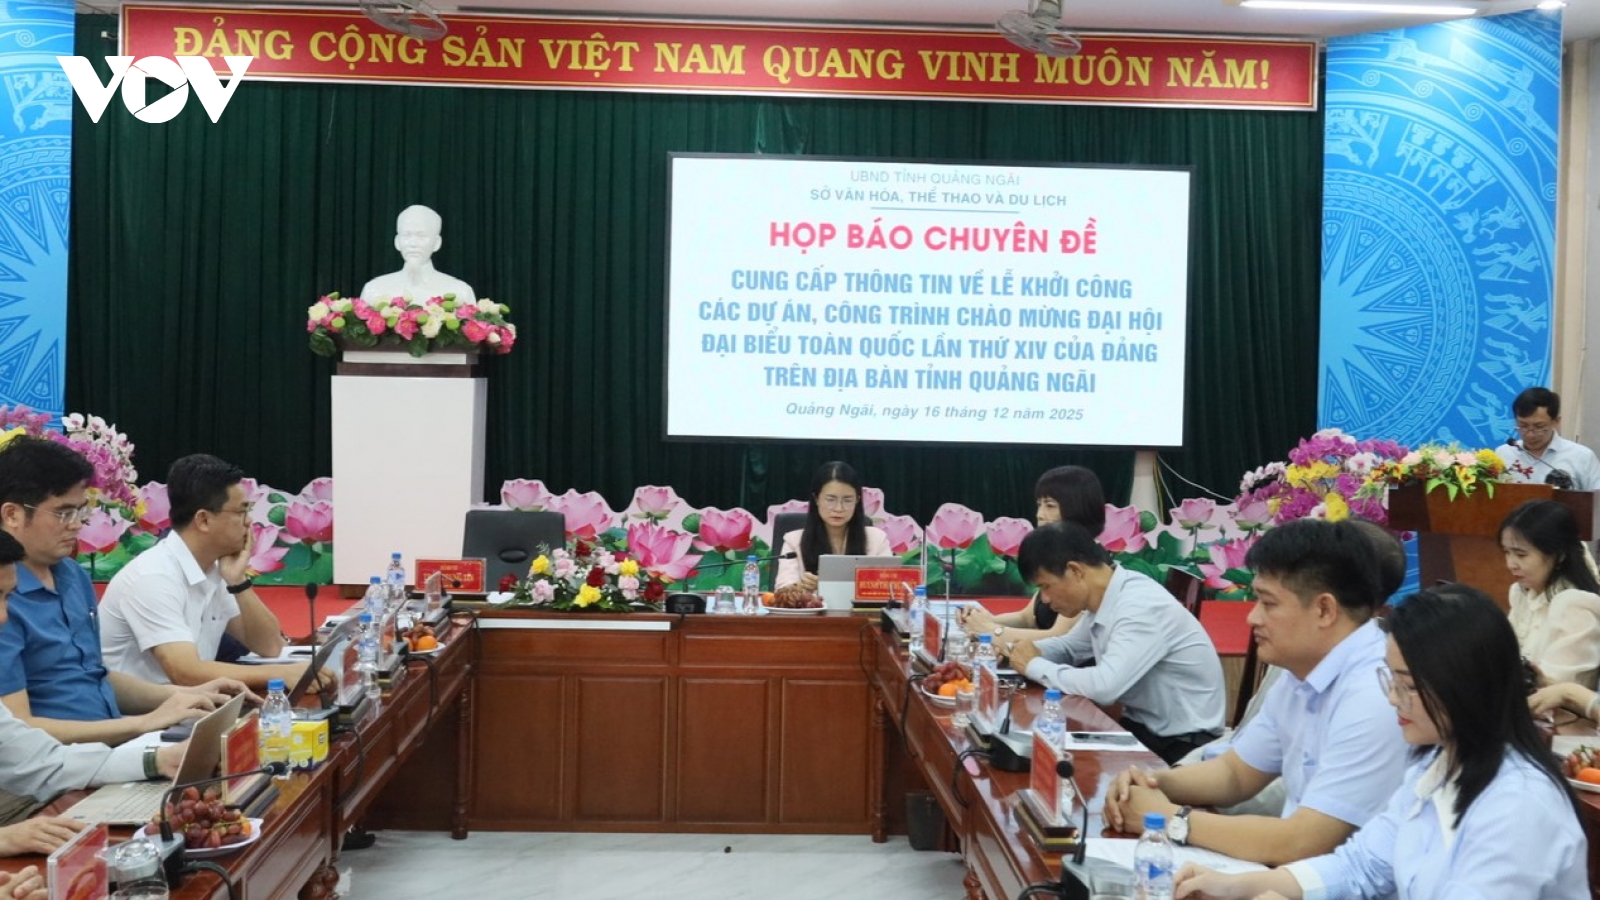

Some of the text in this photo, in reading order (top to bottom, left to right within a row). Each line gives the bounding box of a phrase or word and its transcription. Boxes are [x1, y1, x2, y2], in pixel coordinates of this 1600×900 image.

[174, 17, 1270, 90] ĐẢNG CỘNG SẢN VIỆT NAM QUANG VINH MUÔN NĂM!
[850, 170, 889, 183] UBND
[931, 169, 983, 186] QUẢNG
[810, 185, 1067, 208] SỞ VĂN HÓA, THỂ THAO VÀ DU LỊCH
[769, 217, 1097, 254] HỌP BÁO CHUYÊN ĐỀ
[731, 269, 789, 291] CUNG
[796, 265, 837, 292] CẤP
[844, 268, 913, 293] THÔNG
[919, 274, 952, 294] TIN
[991, 268, 1014, 296] LỄ
[1021, 270, 1069, 297] KHỞI
[1076, 274, 1133, 299] CÔNG
[698, 297, 1163, 336] CÁC DỰ ÁN, CÔNG TRÌNH CHÀO MỪNG ĐẠI HỘI
[701, 325, 1158, 362] ĐẠI BIỂU TOÀN QUỐC LẦN THỨ XIV CỦA ĐẢNG
[764, 362, 1096, 394] TRÊN ĐỊA BÀN TỈNH QUẢNG NGÃI
[785, 401, 1084, 421] Quảng Ngãi, ngày 16 tháng 12 năm 2025
